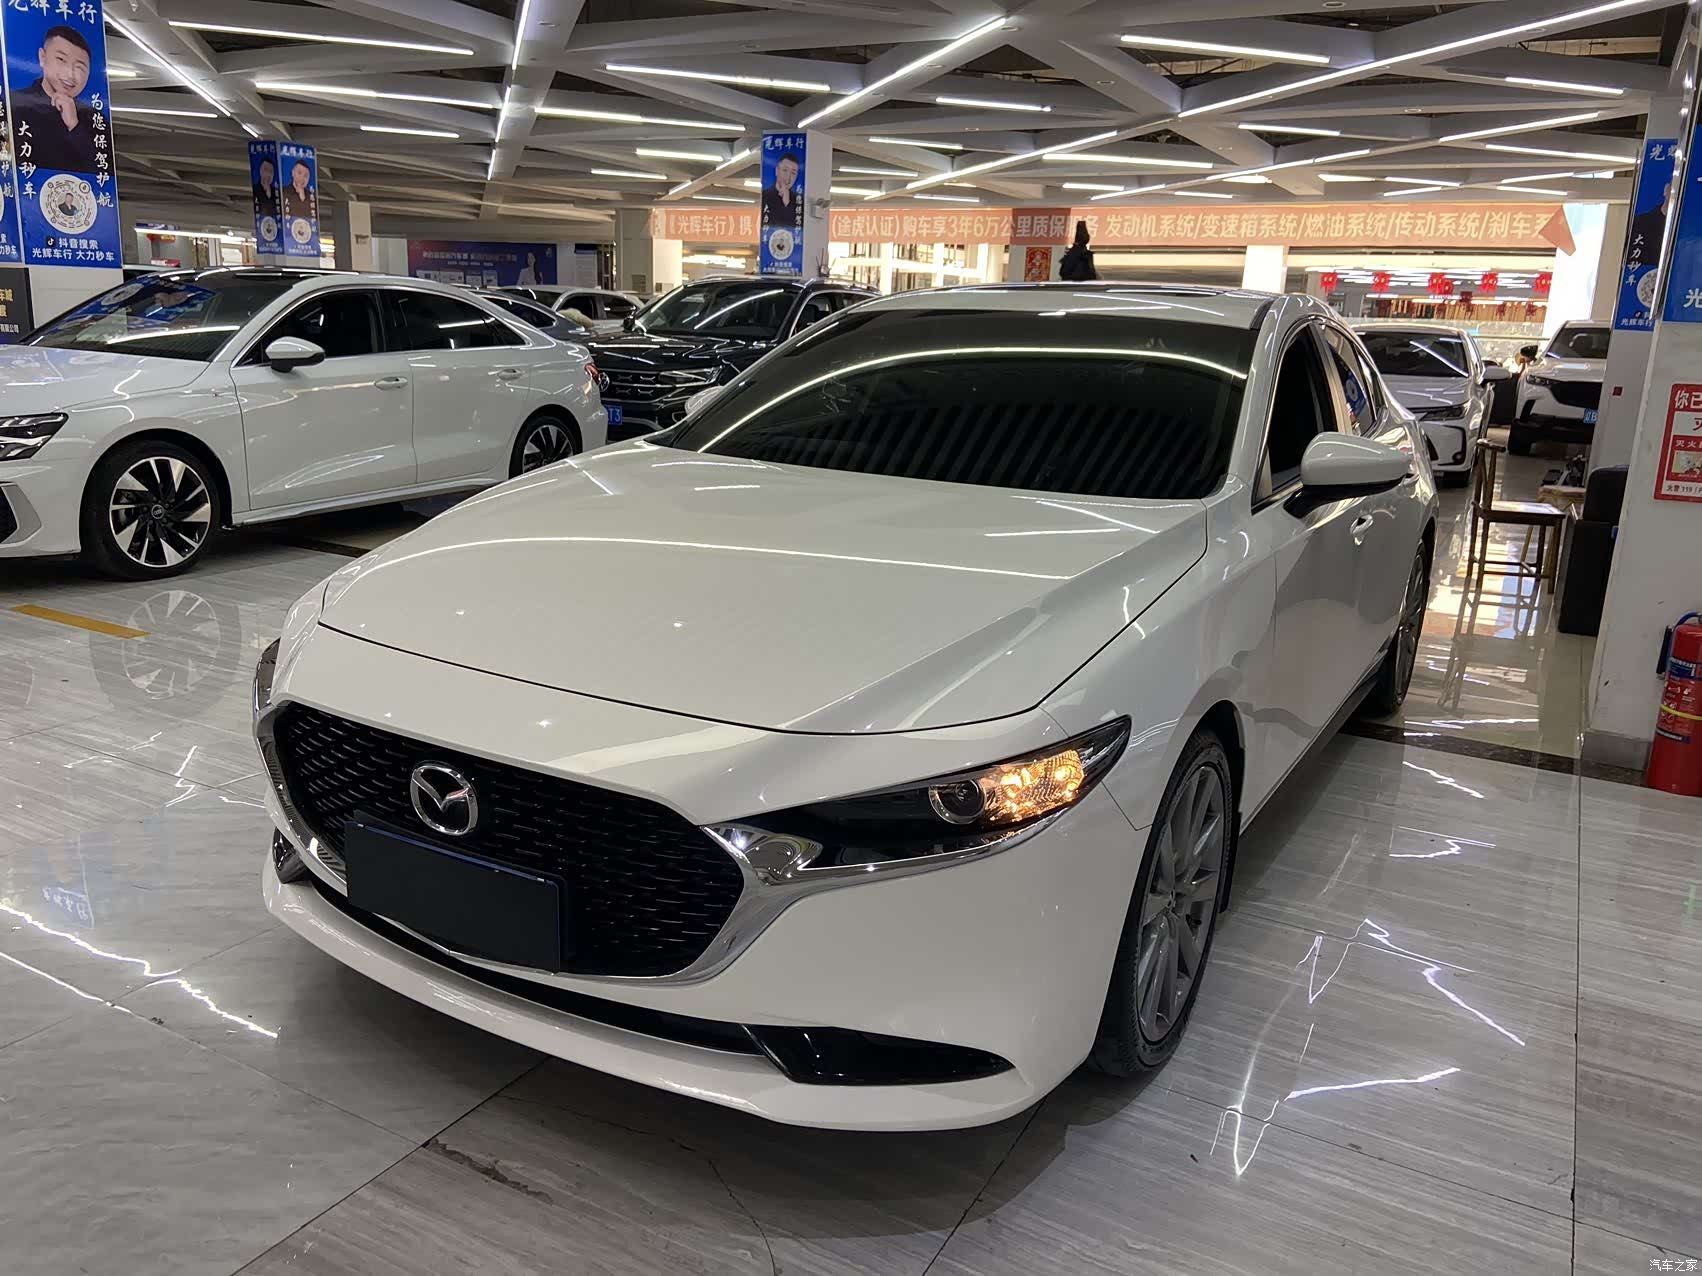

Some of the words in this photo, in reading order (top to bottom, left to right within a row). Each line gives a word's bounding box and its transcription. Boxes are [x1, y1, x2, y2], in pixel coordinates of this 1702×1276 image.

[763, 136, 805, 150] 光辉车行
[91, 93, 114, 208] 为您保驾护航
[18, 121, 37, 200] 大力秒车
[59, 238, 98, 249] 抖音搜索
[32, 248, 72, 260] 光辉车行
[76, 251, 115, 261] 大力秒车
